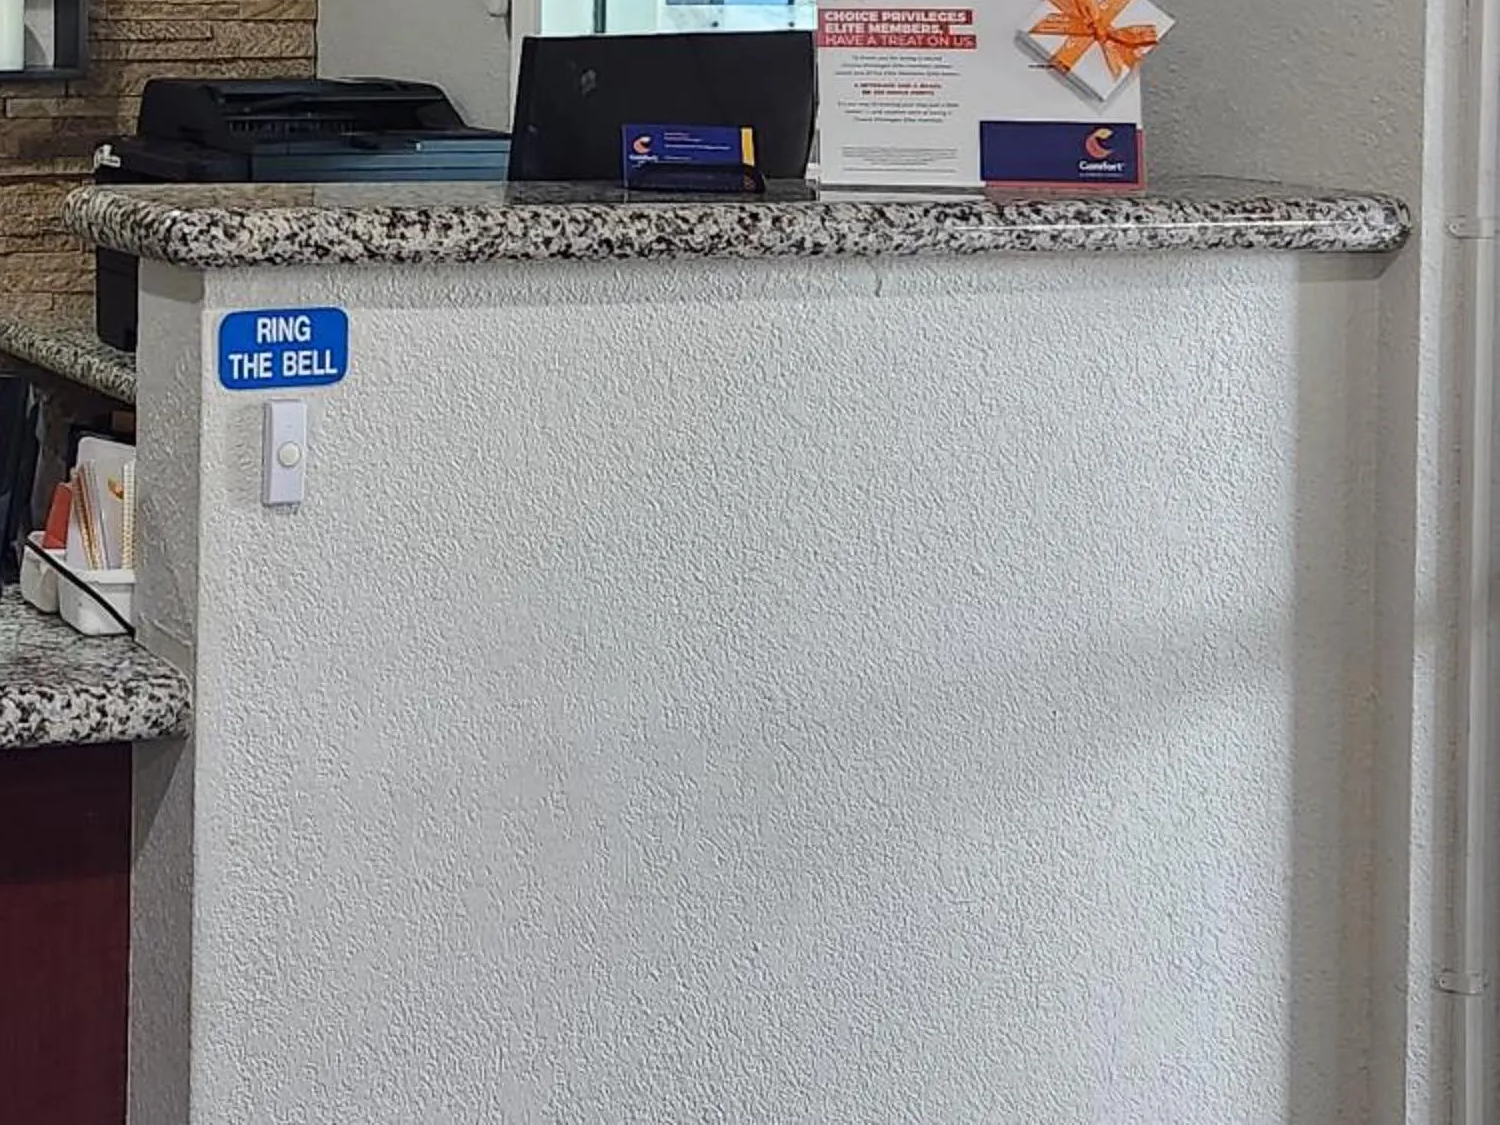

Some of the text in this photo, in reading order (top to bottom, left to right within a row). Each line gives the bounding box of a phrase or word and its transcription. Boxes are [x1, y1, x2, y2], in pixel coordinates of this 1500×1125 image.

[824, 11, 966, 22] CHOICE PRIVILEGES
[825, 23, 864, 33] ELITE
[825, 35, 864, 46] HAVE
[867, 35, 877, 46] A
[882, 35, 925, 46] TREAT
[927, 35, 949, 46] ON
[1079, 160, 1123, 172] Comfort
[256, 315, 311, 344] RING
[228, 349, 338, 380] THE BELL
